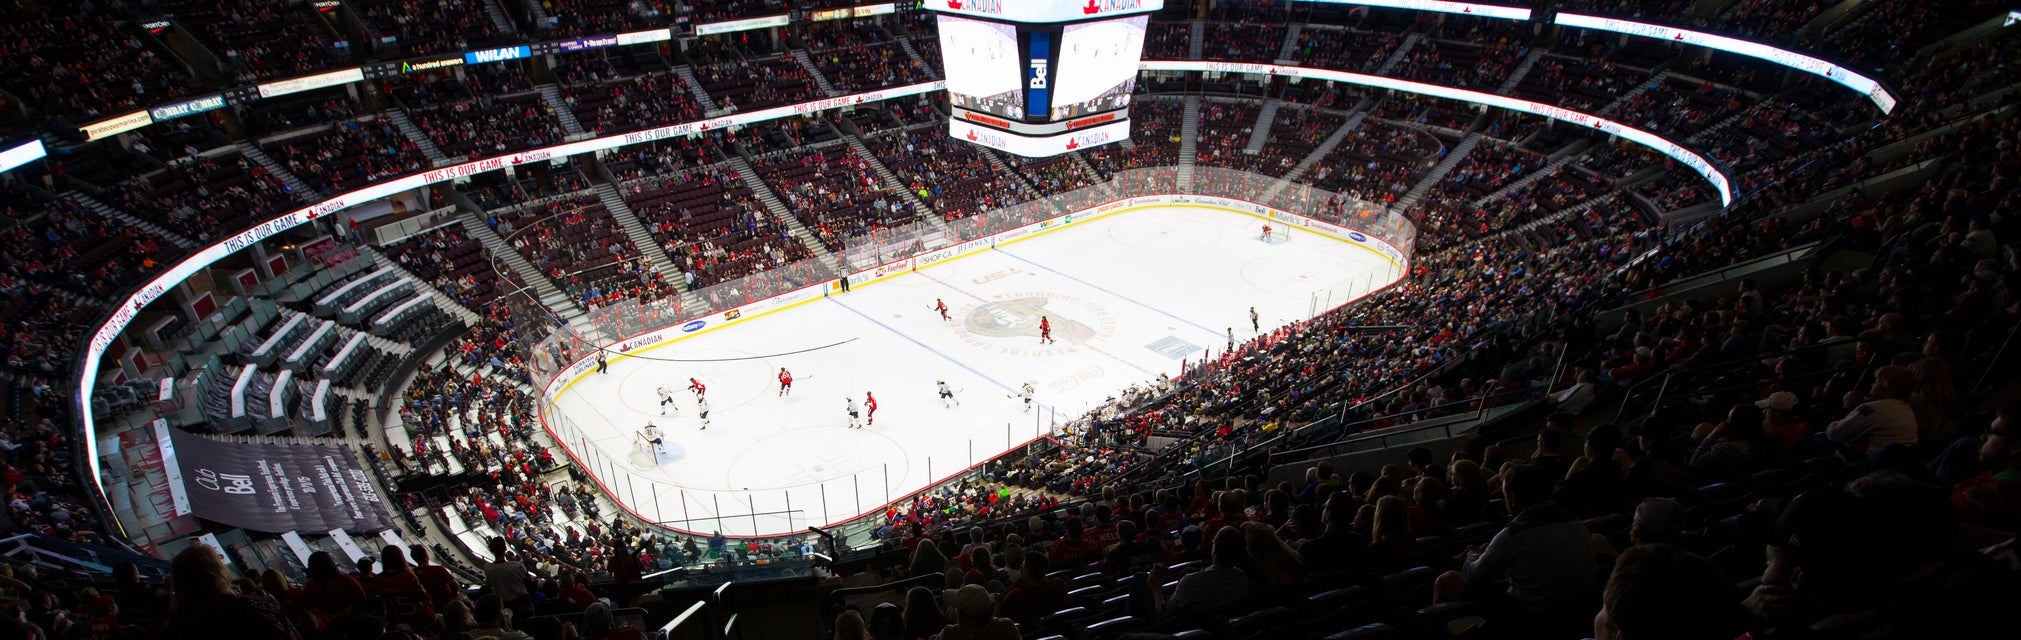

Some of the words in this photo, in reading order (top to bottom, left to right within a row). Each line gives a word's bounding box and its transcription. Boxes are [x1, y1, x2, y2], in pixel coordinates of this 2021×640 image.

[1030, 59, 1047, 89] Bell
[794, 104, 808, 114] THIS
[810, 102, 817, 111] IS
[818, 100, 832, 110] OUR
[833, 97, 850, 107] GAME
[624, 134, 643, 144] THIS
[644, 131, 653, 141] IS
[655, 128, 671, 139] OUR
[673, 124, 694, 136] GAME
[423, 171, 444, 184] THIS
[446, 167, 456, 179] IS
[458, 163, 477, 176] OUR
[1255, 206, 1265, 214] Bell
[224, 235, 245, 254] THIS
[244, 231, 255, 244] IS
[254, 223, 273, 240] OUR
[630, 333, 662, 350] CANADIAN
[573, 355, 594, 370] TURKISH
[574, 361, 595, 375] AIRLINES
[194, 469, 220, 490] Club
[219, 473, 256, 494] Bell
